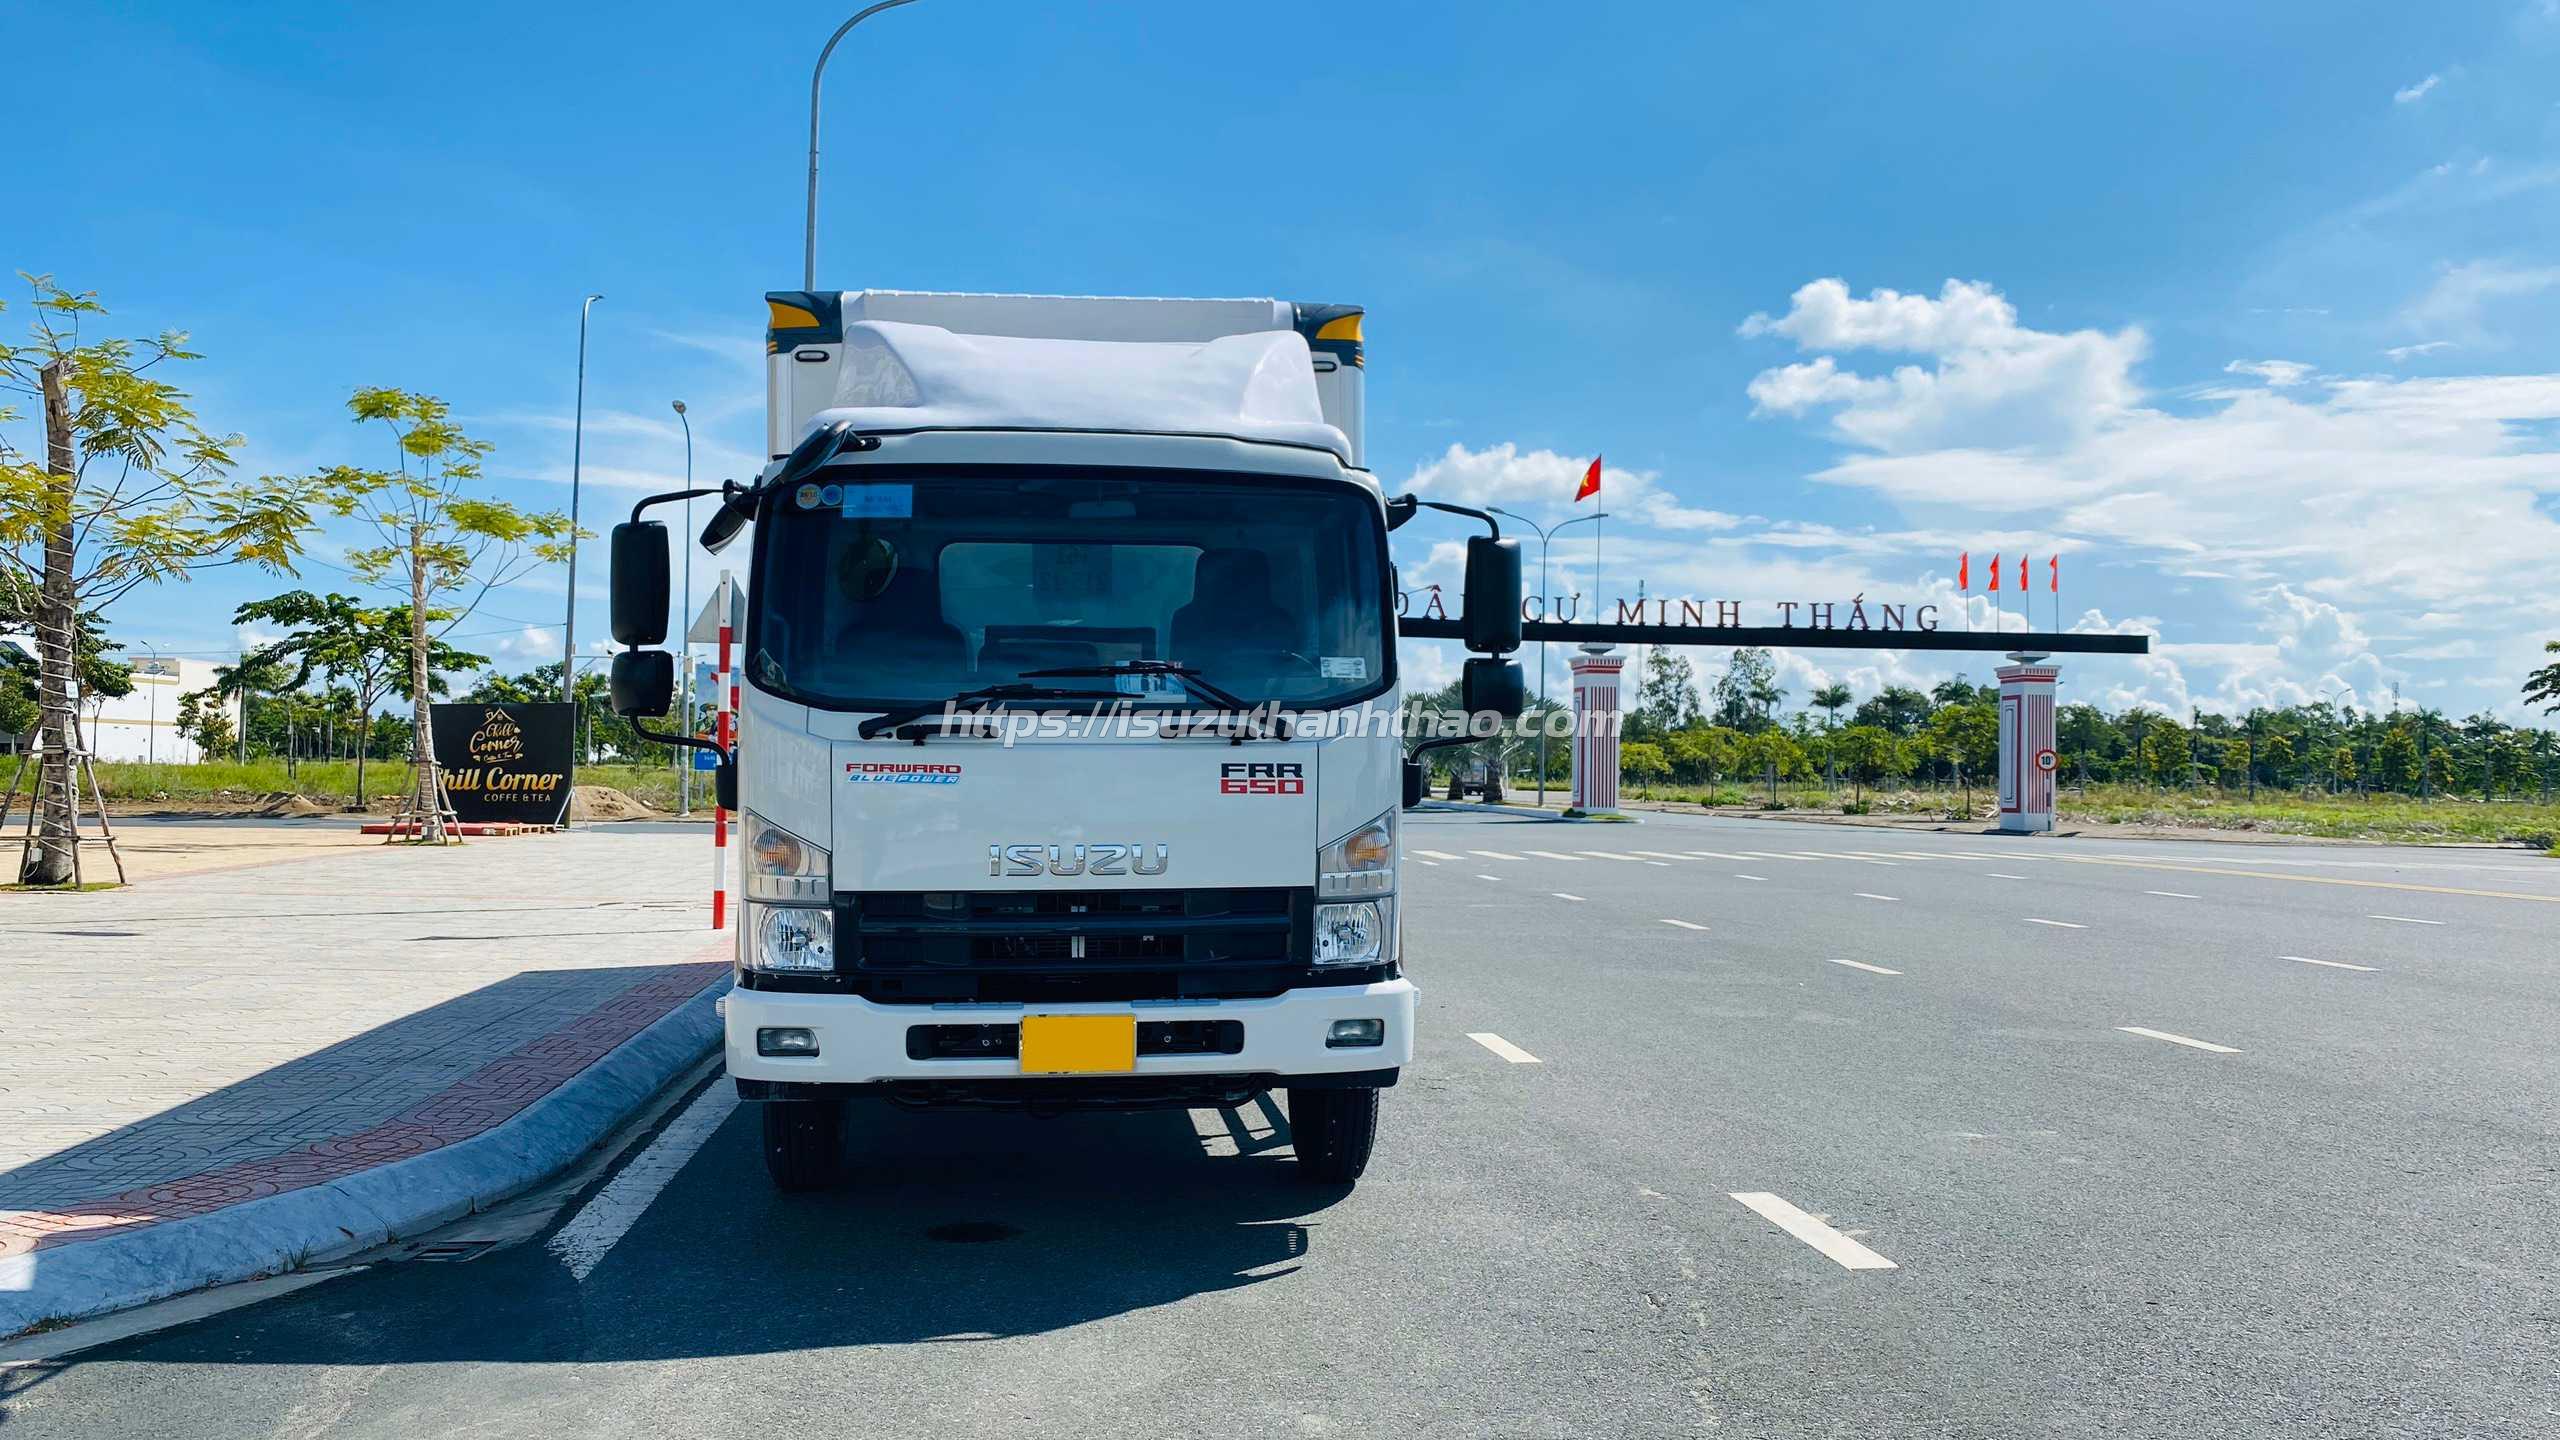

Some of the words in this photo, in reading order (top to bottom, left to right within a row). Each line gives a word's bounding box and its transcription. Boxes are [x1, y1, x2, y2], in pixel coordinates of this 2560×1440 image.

[1616, 597, 1741, 628] MINH
[469, 730, 524, 754] Corner
[846, 763, 962, 774] FORWARD
[1221, 763, 1304, 778] FRR
[486, 766, 563, 791] Corner
[1221, 779, 1304, 794] 650
[484, 793, 518, 802] COFFE
[522, 793, 529, 802] &
[532, 793, 551, 802] TEA
[989, 843, 1169, 877] ISUZU
